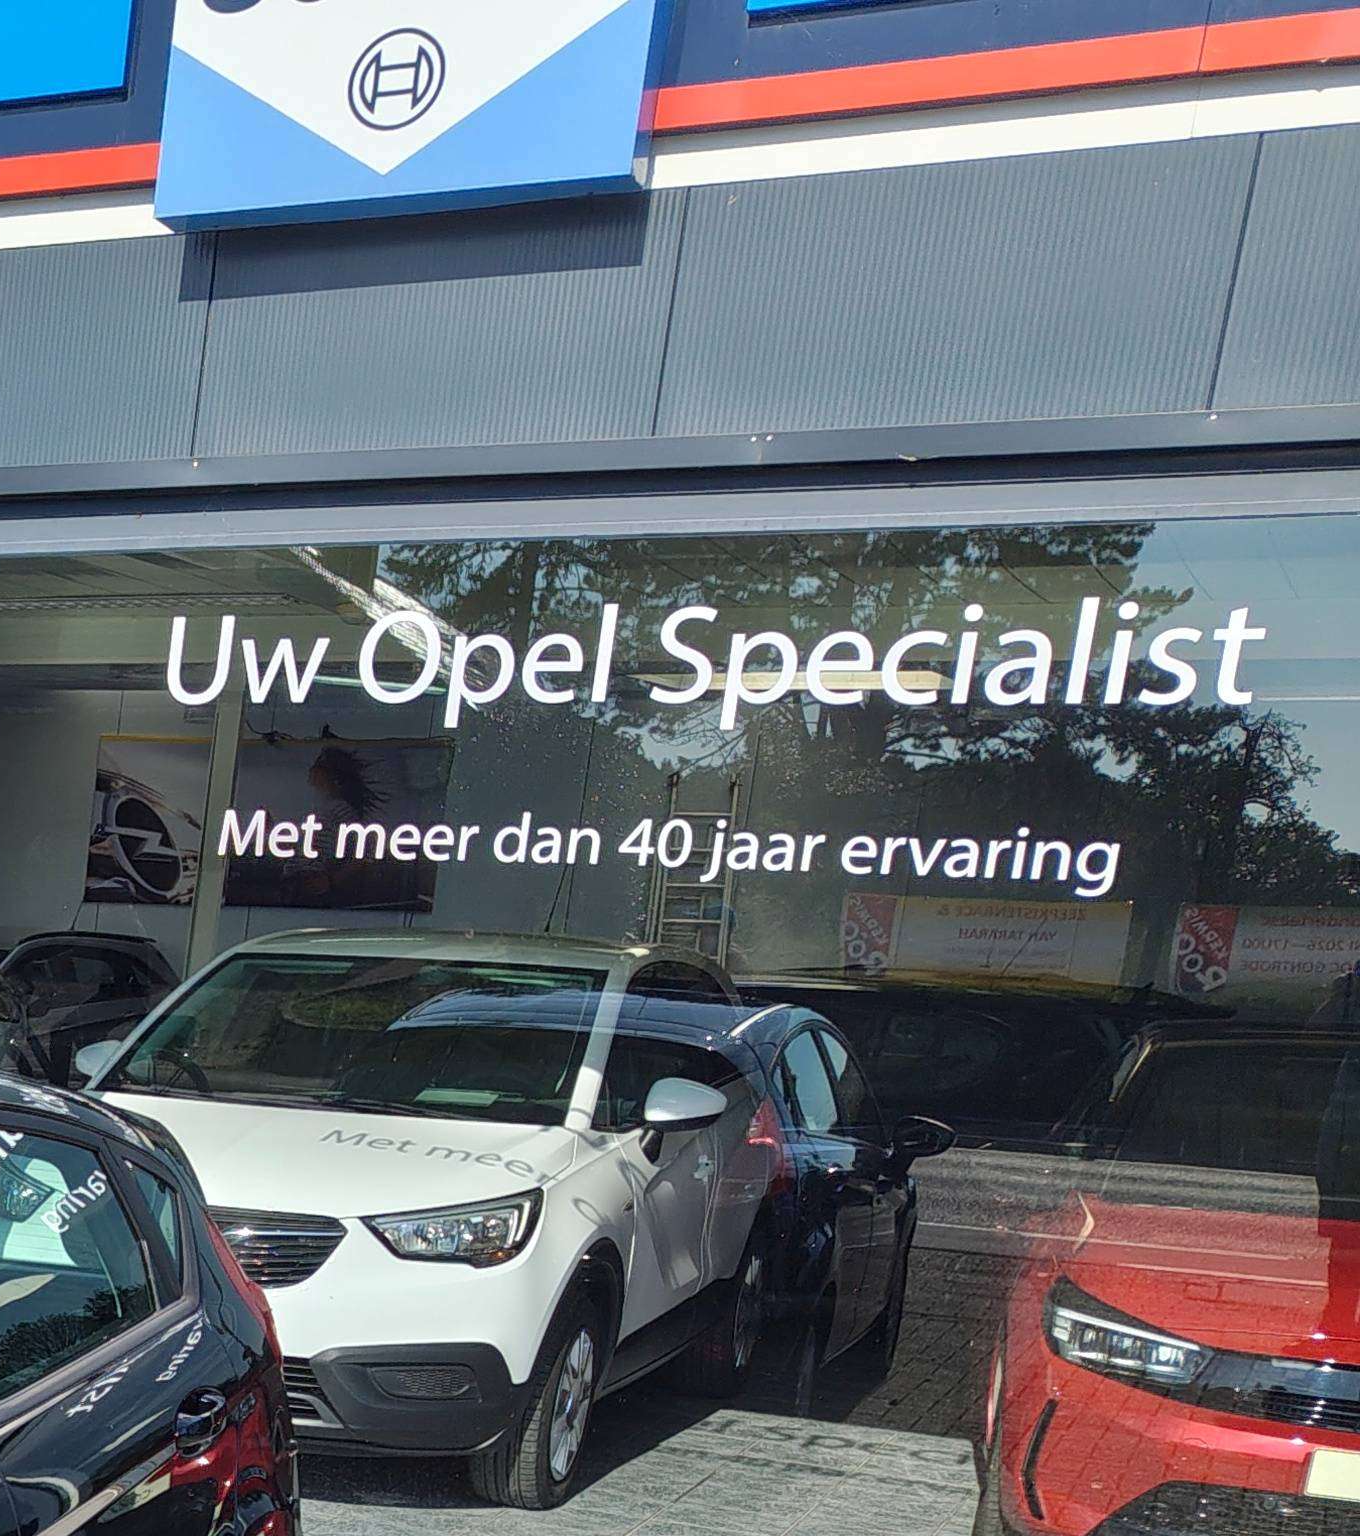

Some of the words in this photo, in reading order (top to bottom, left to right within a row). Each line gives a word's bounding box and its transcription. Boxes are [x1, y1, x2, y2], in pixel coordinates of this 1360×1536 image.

[166, 614, 331, 706] Uw
[358, 602, 620, 729] Opel
[648, 597, 1268, 732] Specialist
[216, 808, 323, 860] Met
[335, 822, 481, 862] meer
[492, 810, 602, 866] dan
[617, 817, 694, 869] 40
[699, 818, 827, 884] jaar
[840, 826, 1121, 898] ervaring
